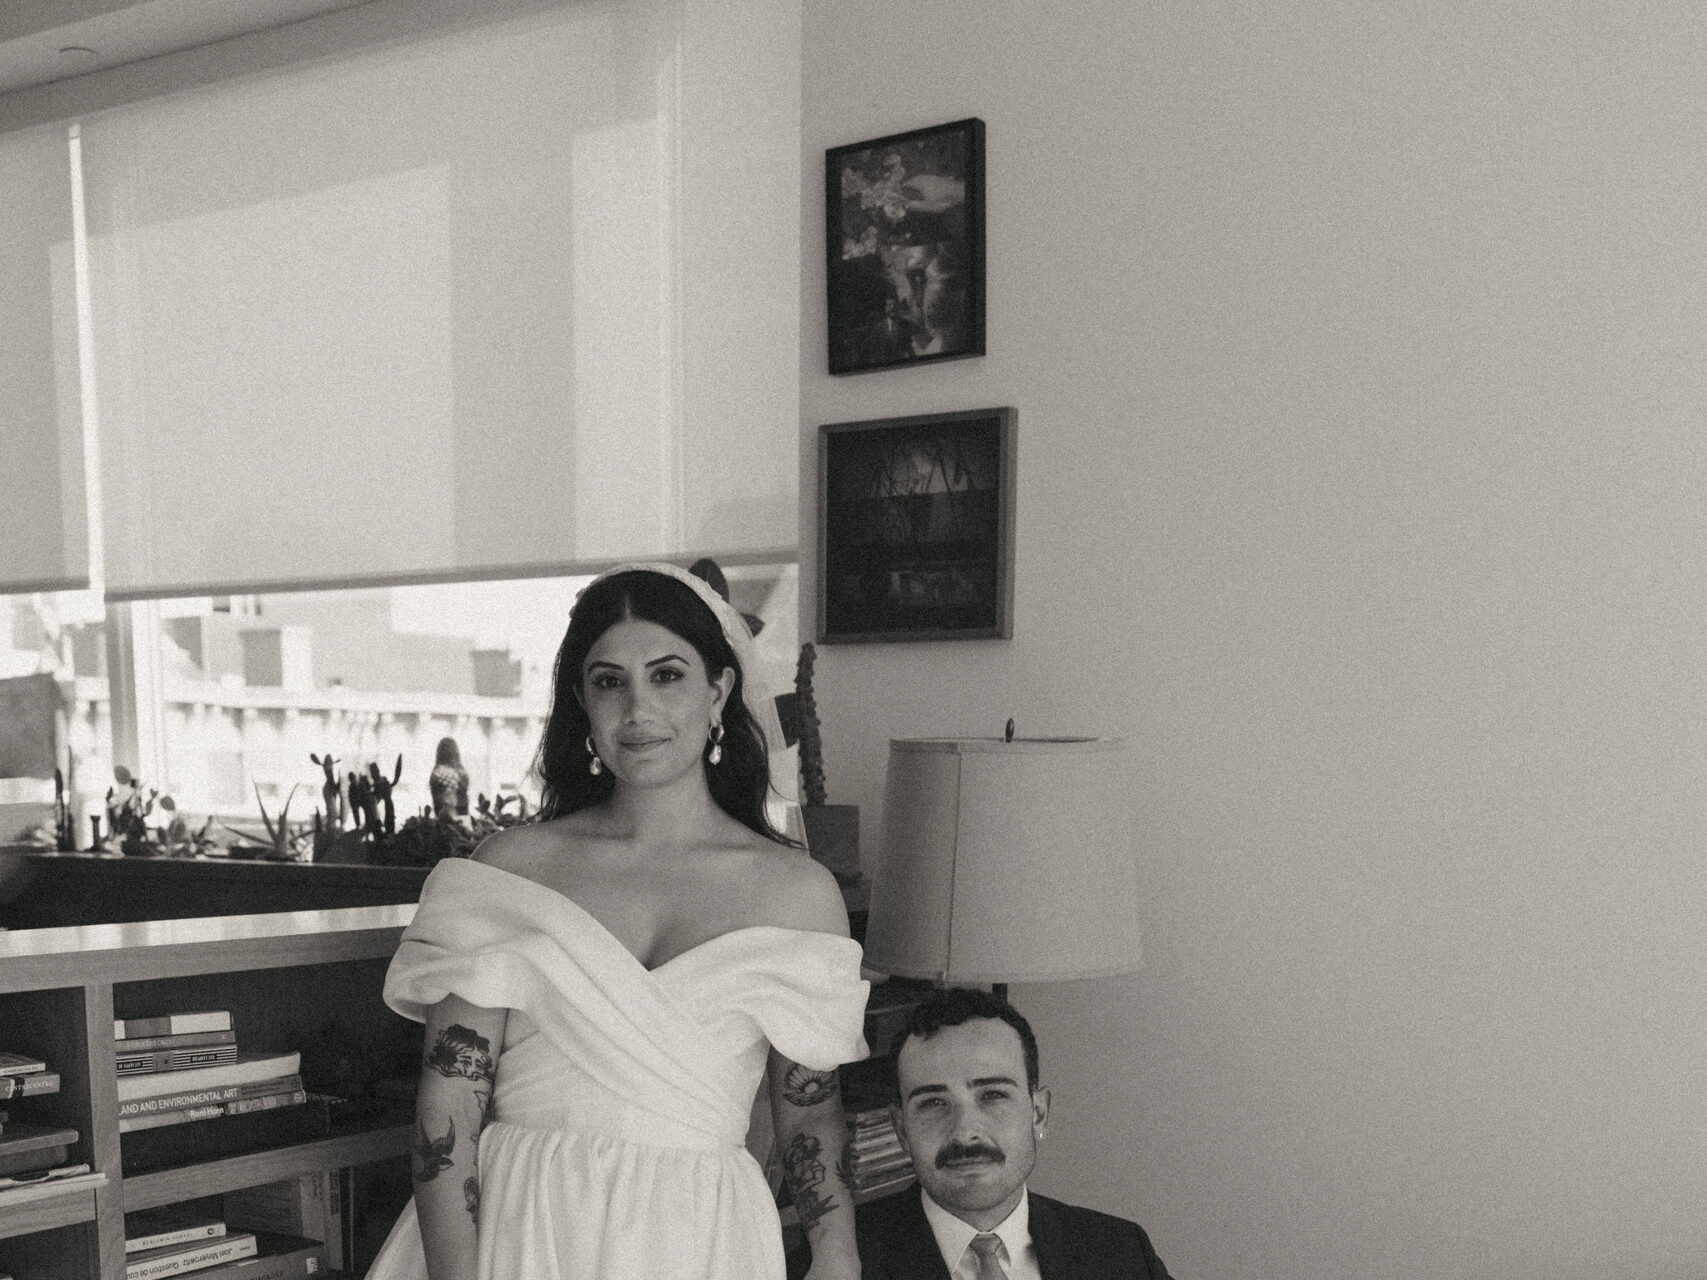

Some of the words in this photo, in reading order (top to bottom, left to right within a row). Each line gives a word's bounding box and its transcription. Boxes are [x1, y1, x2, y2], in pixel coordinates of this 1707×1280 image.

[118, 1105, 139, 1115] AND
[140, 1102, 157, 1111] AND
[158, 1091, 222, 1109] ENVIRONMENTAL
[223, 1088, 238, 1098] ART
